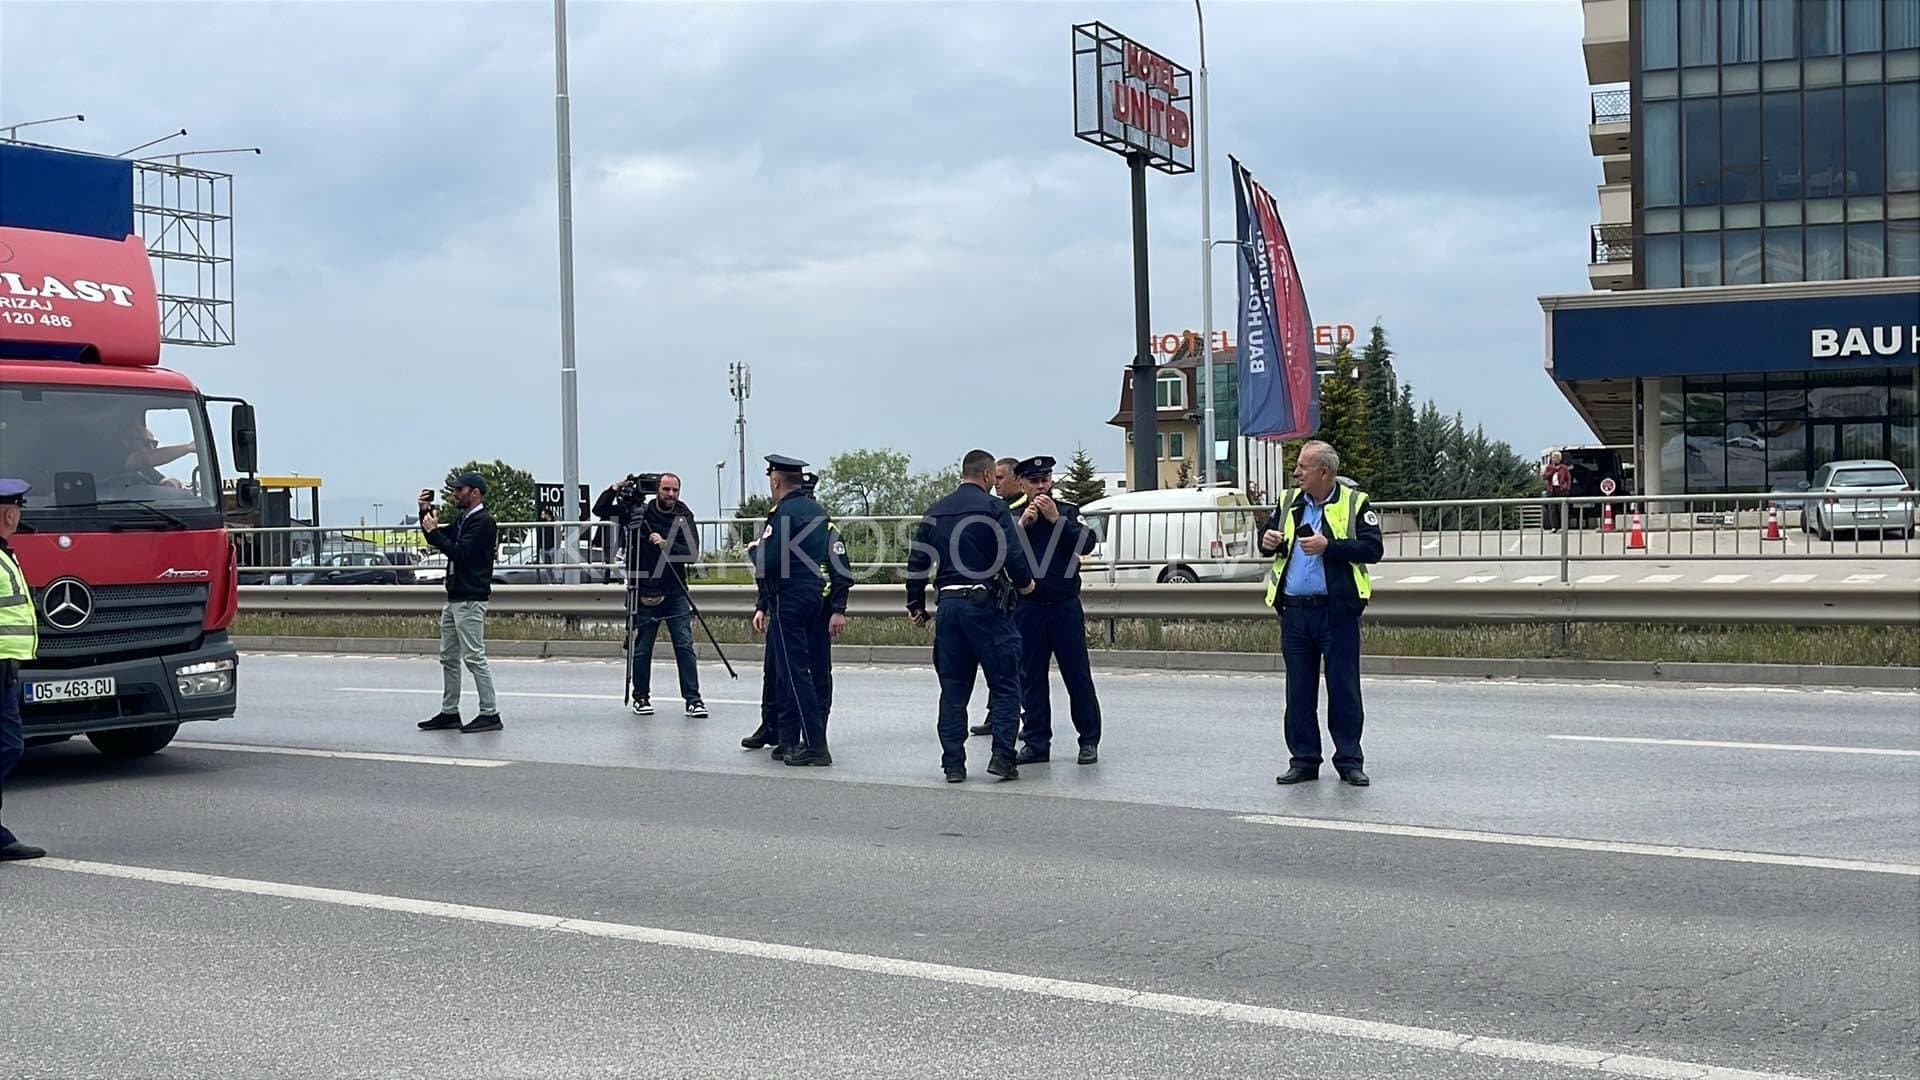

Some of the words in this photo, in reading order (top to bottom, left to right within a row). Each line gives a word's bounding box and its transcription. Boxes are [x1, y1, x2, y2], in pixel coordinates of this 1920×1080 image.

[1121, 40, 1179, 96] HOTEL
[1110, 79, 1190, 148] UNITED
[0, 271, 134, 307] LAST
[2, 311, 35, 325] 120
[40, 313, 73, 328] 486
[1812, 325, 1902, 357] BAU
